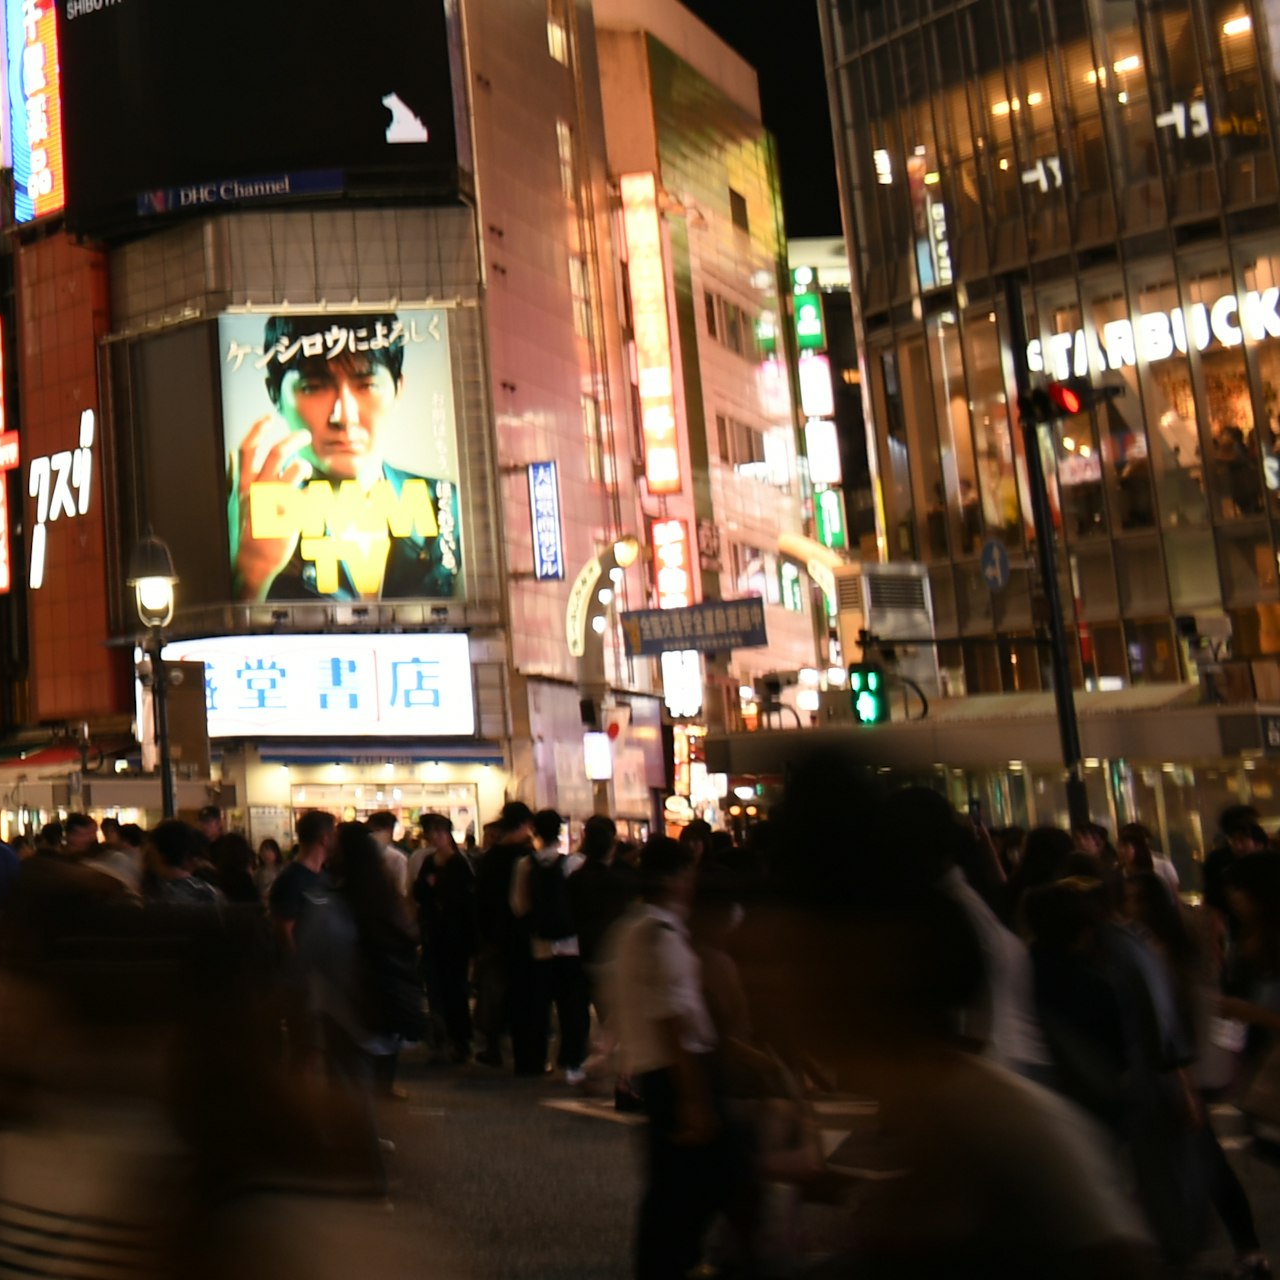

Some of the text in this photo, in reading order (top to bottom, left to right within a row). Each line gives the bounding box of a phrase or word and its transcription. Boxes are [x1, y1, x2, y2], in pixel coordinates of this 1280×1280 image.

[180, 175, 290, 207] DHC Channel
[227, 314, 441, 370] ケンシロウによろしく
[29, 408, 95, 589] クスリ
[249, 479, 439, 539] DMM
[300, 536, 392, 594] TV
